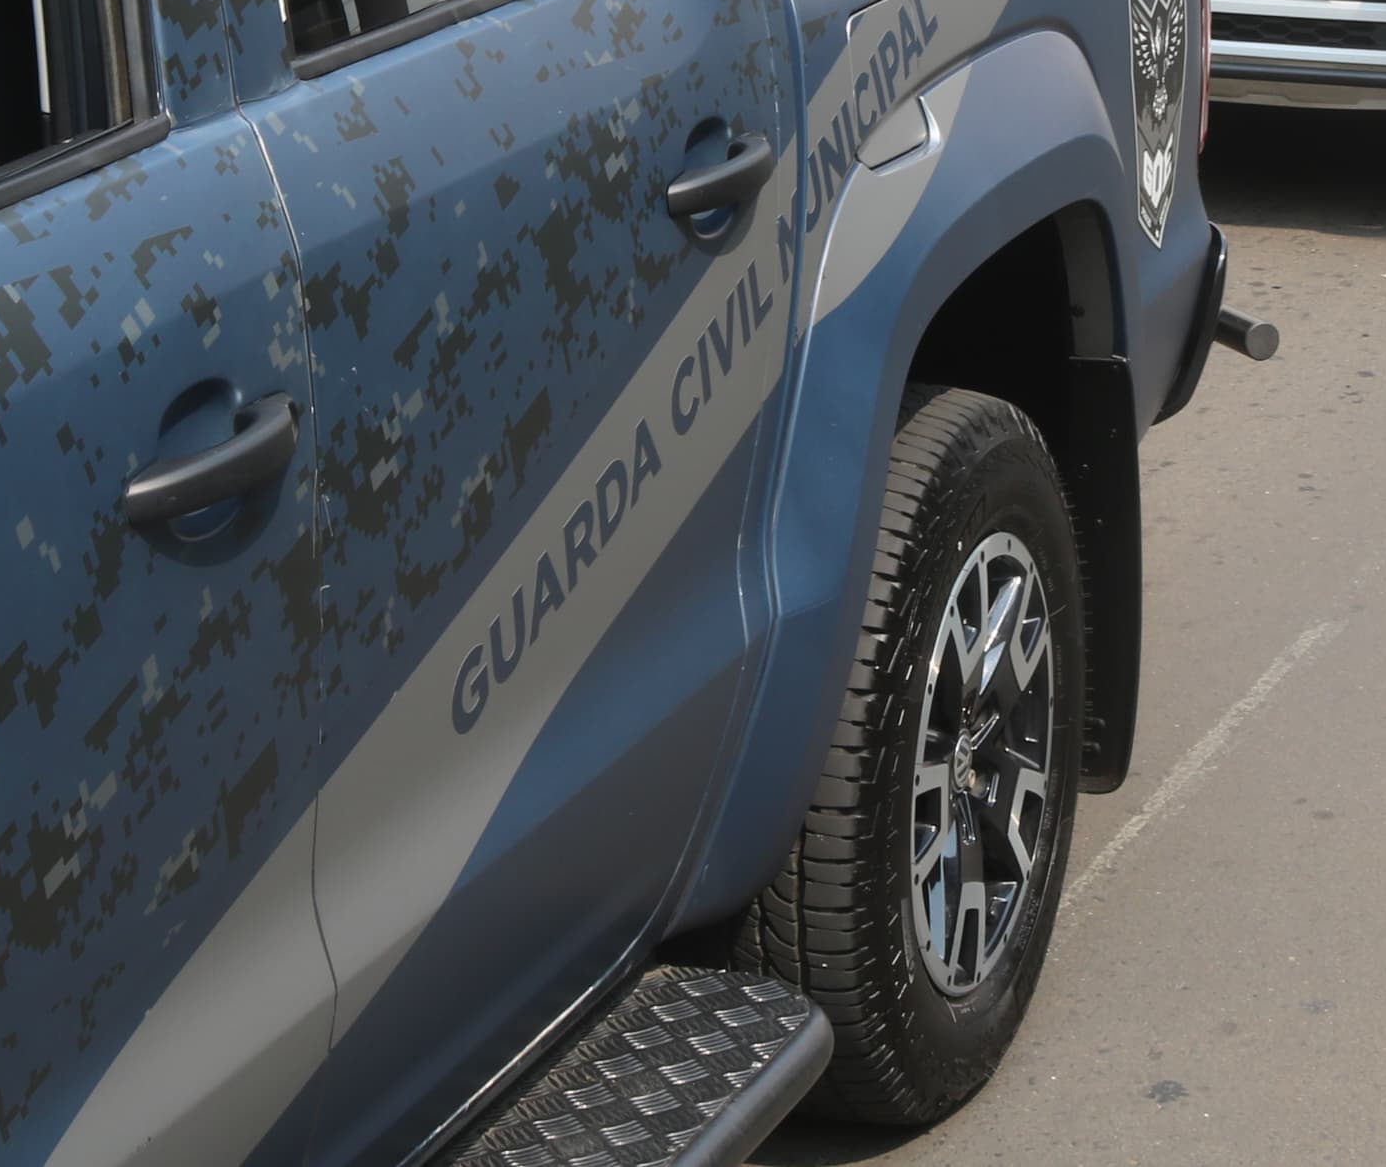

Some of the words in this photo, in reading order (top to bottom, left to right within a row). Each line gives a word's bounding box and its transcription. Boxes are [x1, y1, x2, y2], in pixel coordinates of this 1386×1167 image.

[1143, 132, 1174, 209] GOE
[451, 417, 663, 736] GUARDA
[669, 260, 774, 437] CIVIL
